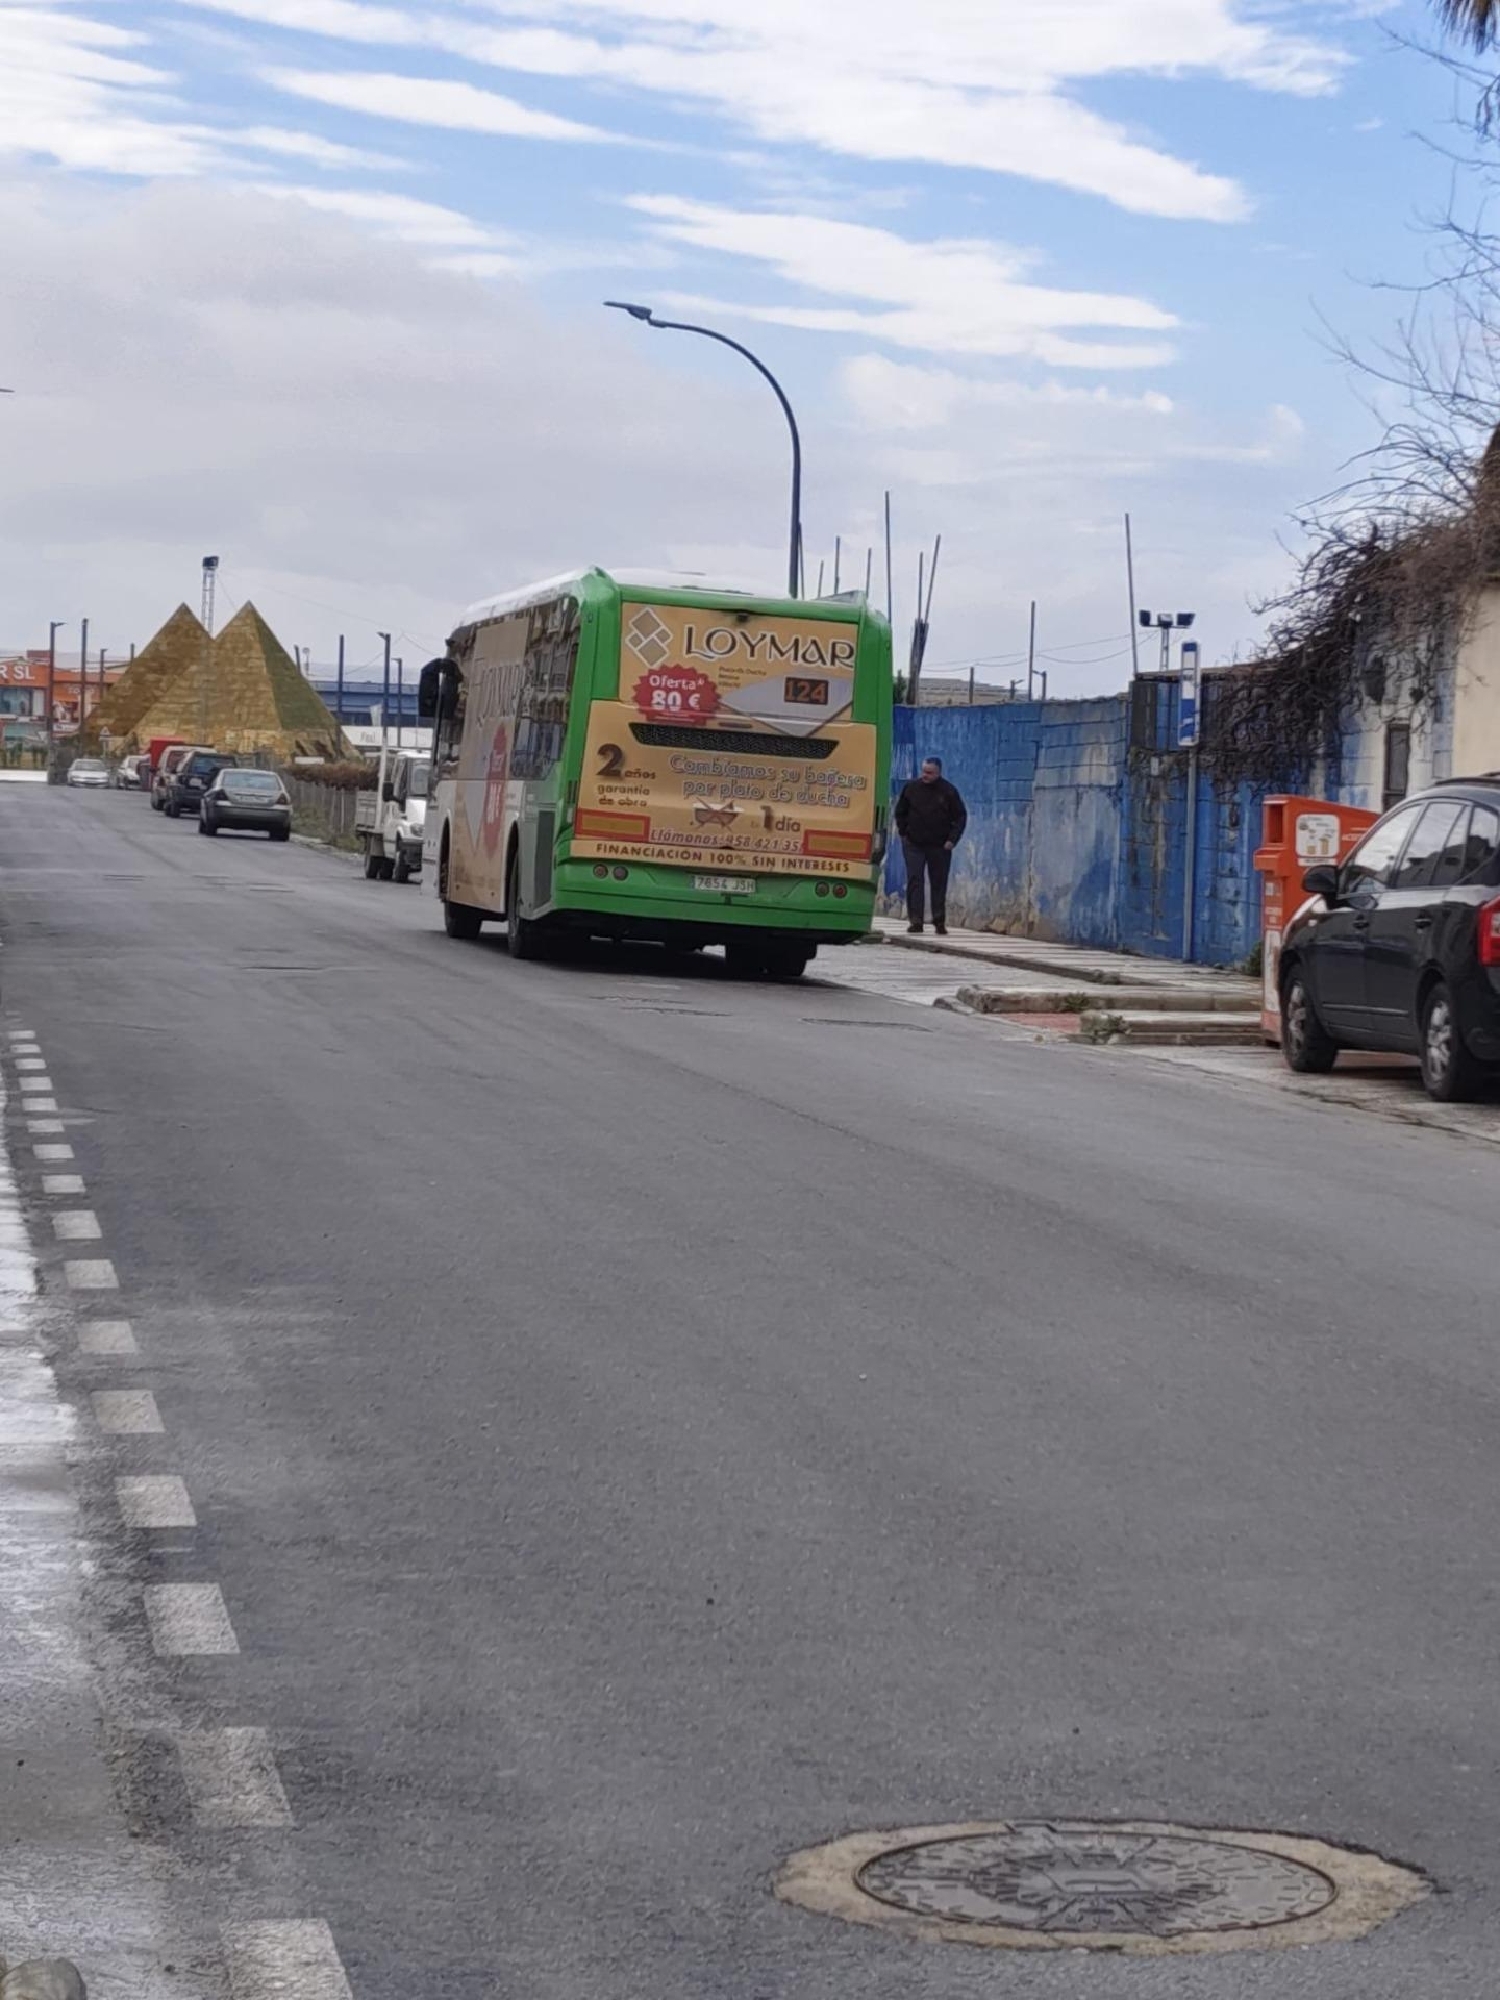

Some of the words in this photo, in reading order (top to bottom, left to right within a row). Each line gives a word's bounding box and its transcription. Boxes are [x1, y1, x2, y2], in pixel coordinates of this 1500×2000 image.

[683, 625, 856, 670] LOYMAR
[13, 665, 36, 680] SL
[651, 690, 682, 712] 80
[688, 693, 701, 710] €
[785, 679, 827, 704] 124
[596, 743, 624, 777] 2
[624, 768, 656, 780] años
[780, 769, 800, 783] su
[775, 816, 801, 833] día
[710, 852, 746, 866] 100%
[752, 857, 776, 868] SIN
[781, 860, 850, 873] INTERESES
